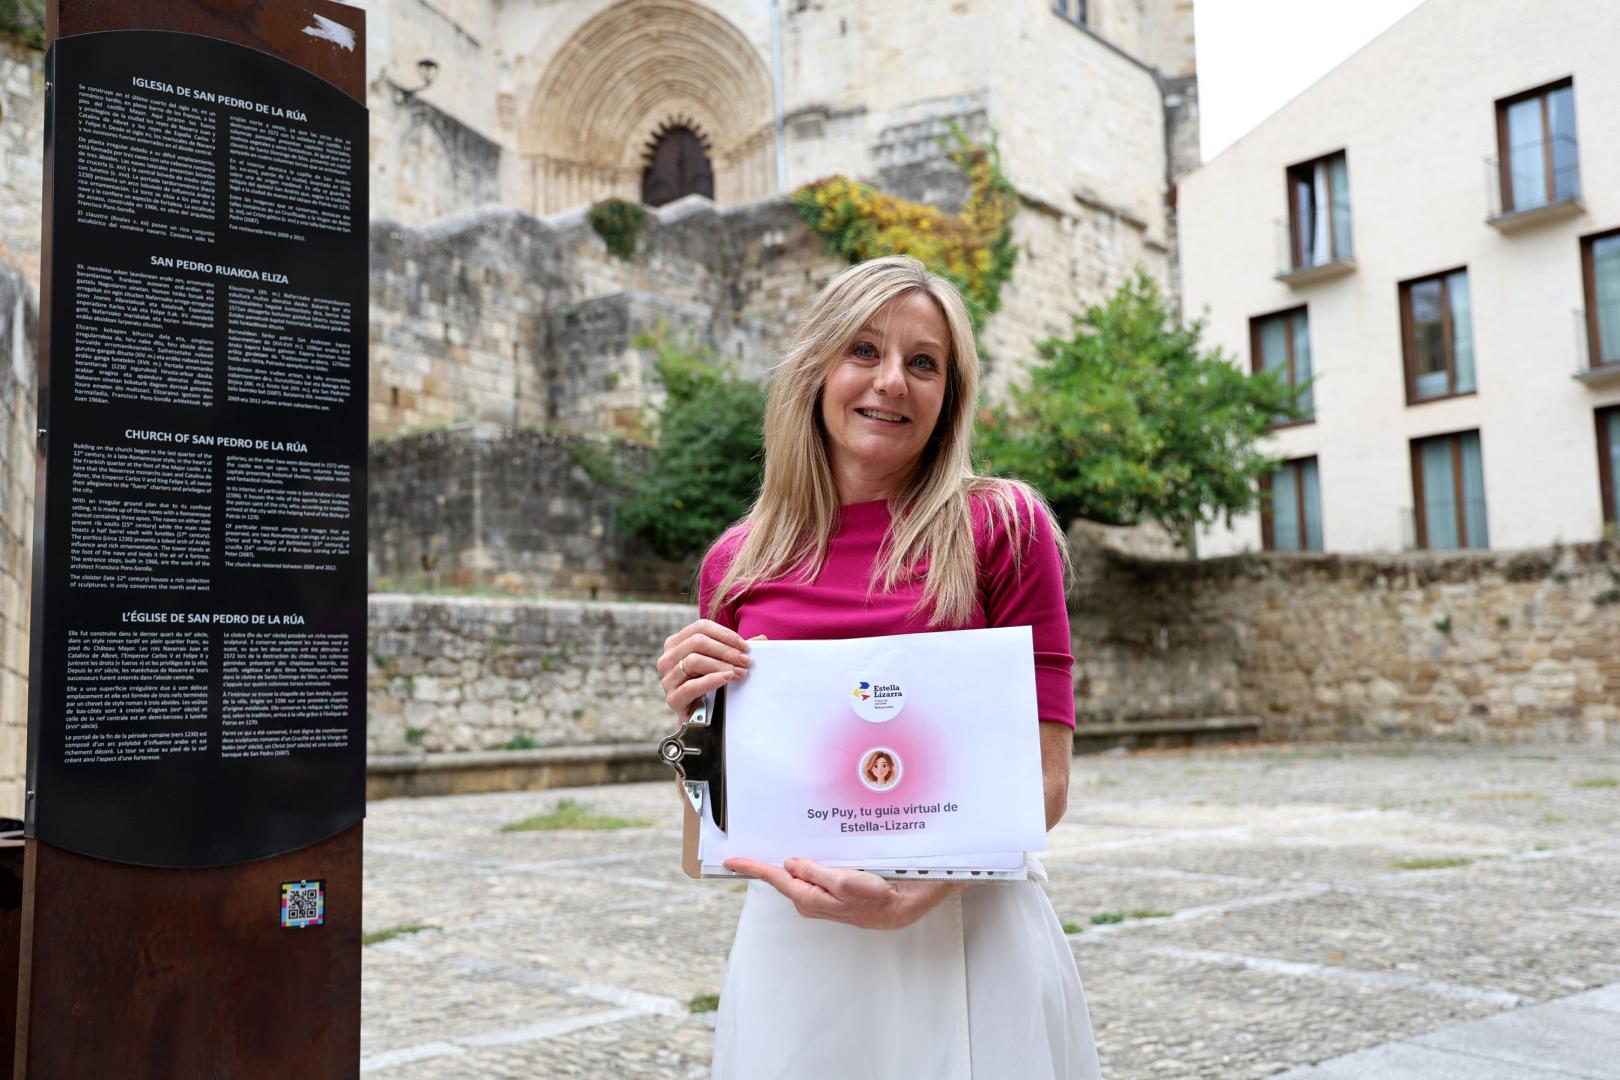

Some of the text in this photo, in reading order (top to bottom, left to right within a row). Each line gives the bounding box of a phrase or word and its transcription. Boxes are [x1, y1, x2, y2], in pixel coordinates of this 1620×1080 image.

[133, 77, 307, 122] IGLESIA DE SAN PEDRO DE LA RÚA
[151, 256, 173, 267] SAN
[177, 260, 213, 273] PEDRO
[216, 265, 259, 280] RUAKOA
[125, 429, 308, 452] CHURCH OF SAN PEDRO DE LA RÚA
[171, 613, 185, 622] DE
[188, 614, 210, 623] SAN
[213, 614, 249, 624] PEDRO
[252, 615, 265, 624] DE
[268, 615, 280, 624] LA
[283, 614, 304, 624] RÚA
[874, 684, 900, 692] Estella
[808, 809, 828, 820] Soy
[832, 808, 857, 819] Puy,
[860, 807, 872, 816] tu
[903, 803, 940, 814] virtual
[944, 803, 958, 812] de
[840, 819, 925, 832] Estella-Lizarra
